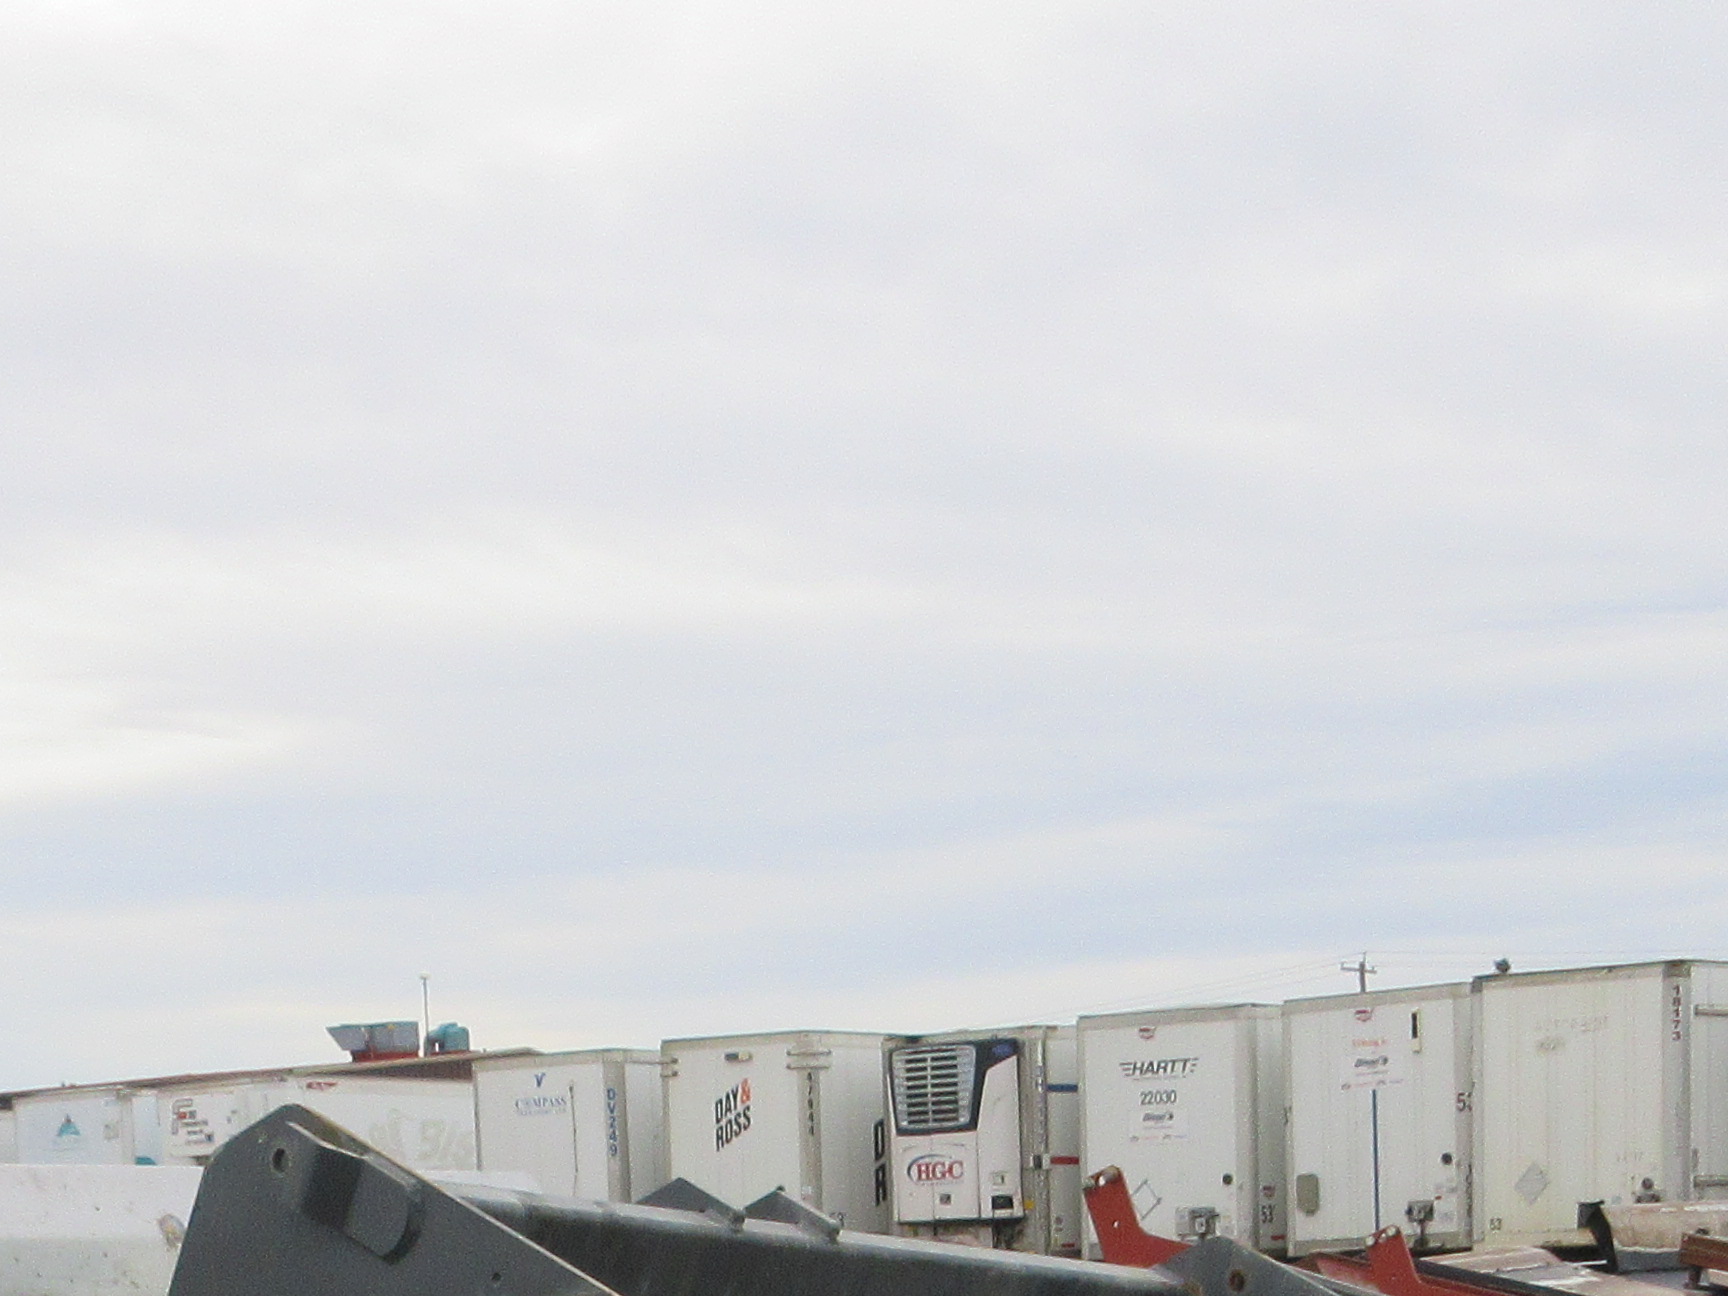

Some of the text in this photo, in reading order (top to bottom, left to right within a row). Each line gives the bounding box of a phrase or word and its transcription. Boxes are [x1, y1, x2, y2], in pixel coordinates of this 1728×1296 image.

[1130, 1057, 1192, 1077] HARTT
[714, 1083, 740, 1125] DAY
[1140, 1088, 1178, 1107] 22030
[714, 1104, 752, 1153] ROSS
